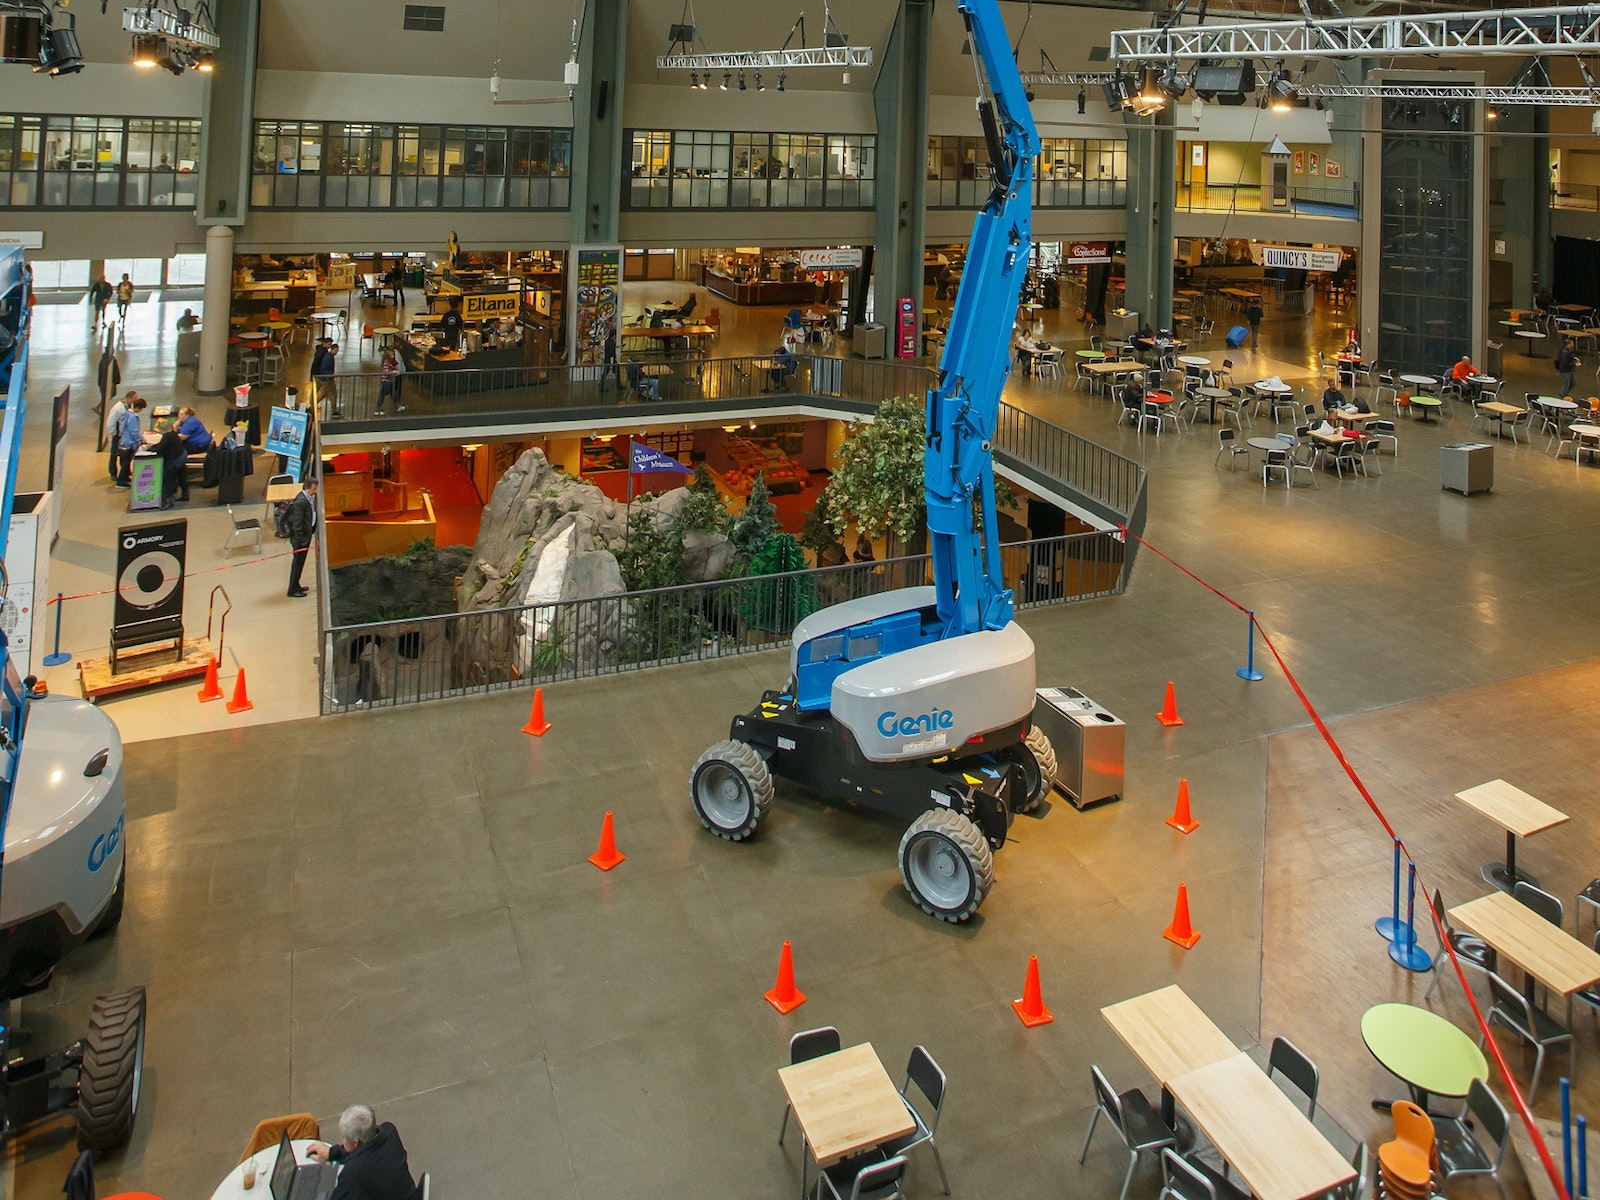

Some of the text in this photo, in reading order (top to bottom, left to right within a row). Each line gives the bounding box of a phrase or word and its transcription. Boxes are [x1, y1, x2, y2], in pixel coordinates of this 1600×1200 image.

[1267, 250, 1307, 267] QUINCY'S
[468, 297, 515, 311] Eltana
[633, 452, 662, 463] Children's
[137, 535, 164, 545] ARMORY
[877, 706, 954, 738] Genie
[87, 814, 125, 873] Gen
